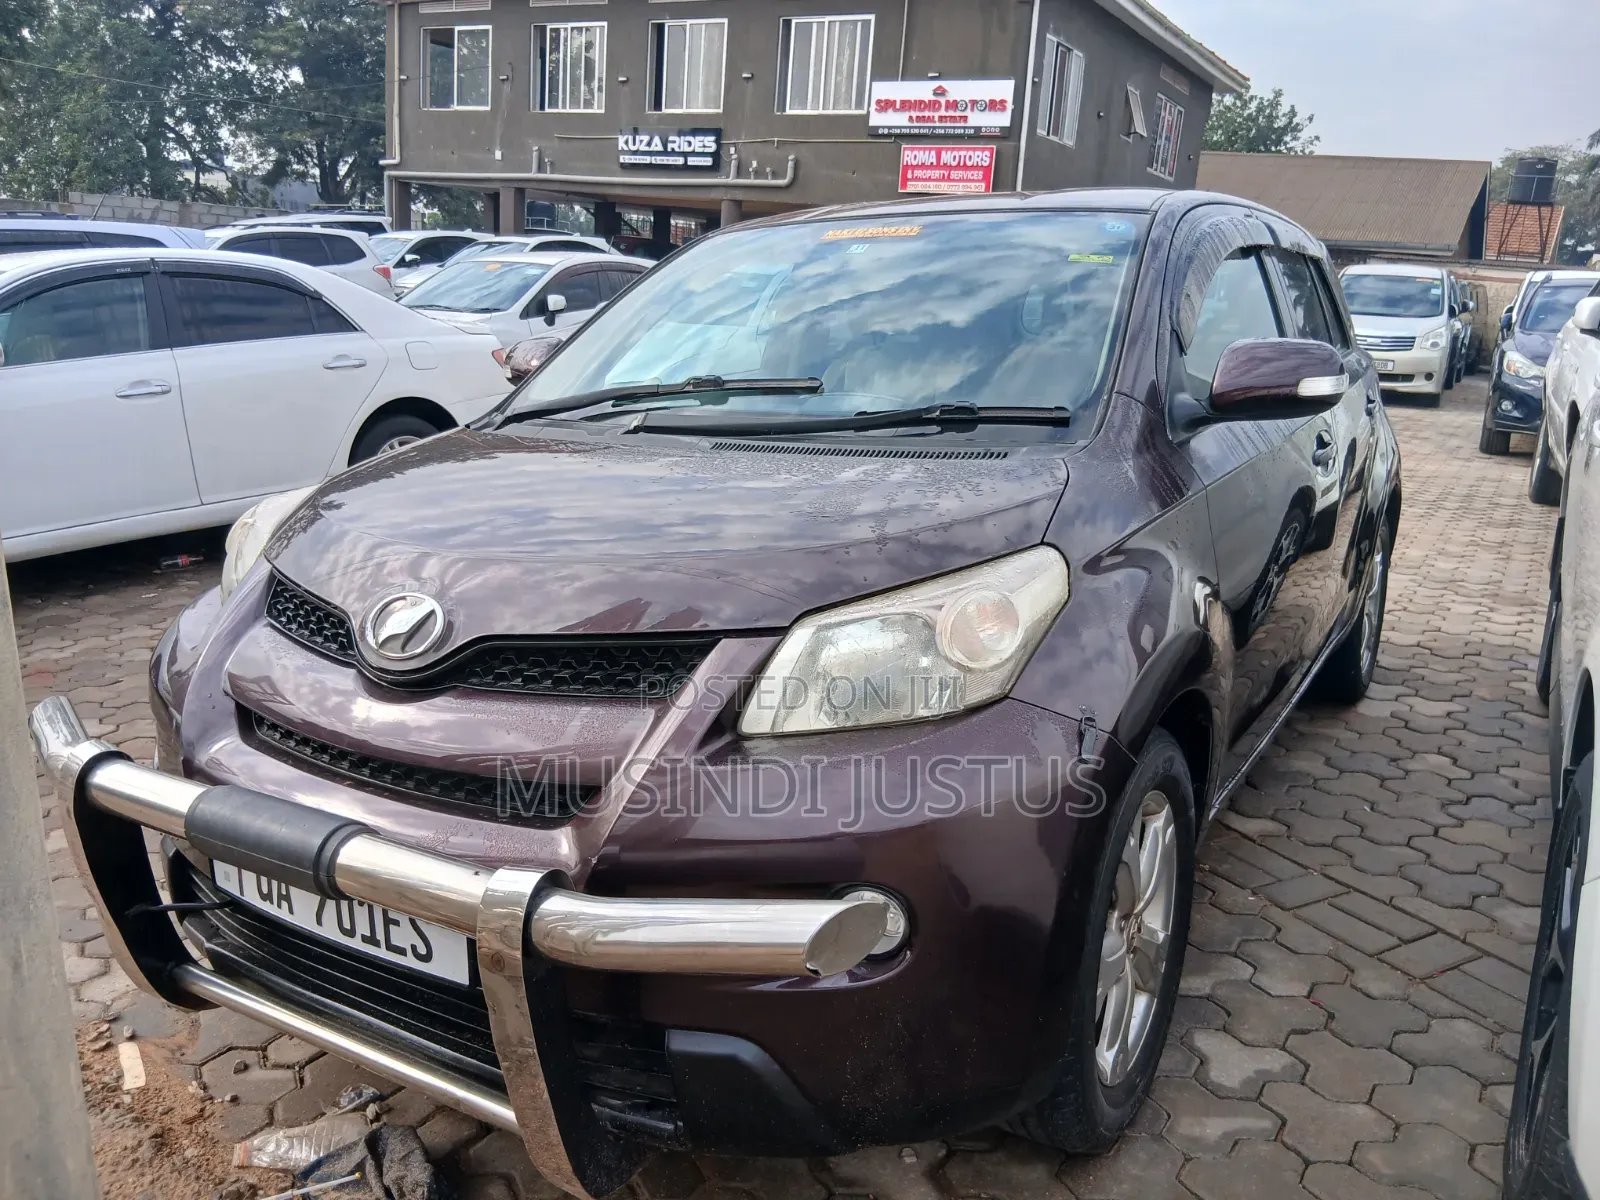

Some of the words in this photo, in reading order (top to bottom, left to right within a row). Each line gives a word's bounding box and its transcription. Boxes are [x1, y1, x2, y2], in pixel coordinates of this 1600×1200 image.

[874, 99, 942, 113] SPLENDID
[944, 99, 1007, 112] MOTORS
[937, 115, 968, 123] ESTATE
[618, 135, 664, 151] KUZA
[667, 136, 717, 152] RIDES
[904, 150, 937, 166] ROMA
[940, 151, 990, 167] MOTORS
[907, 170, 912, 179] &
[913, 170, 949, 179] PROPERTY
[949, 170, 983, 180] SERVICES
